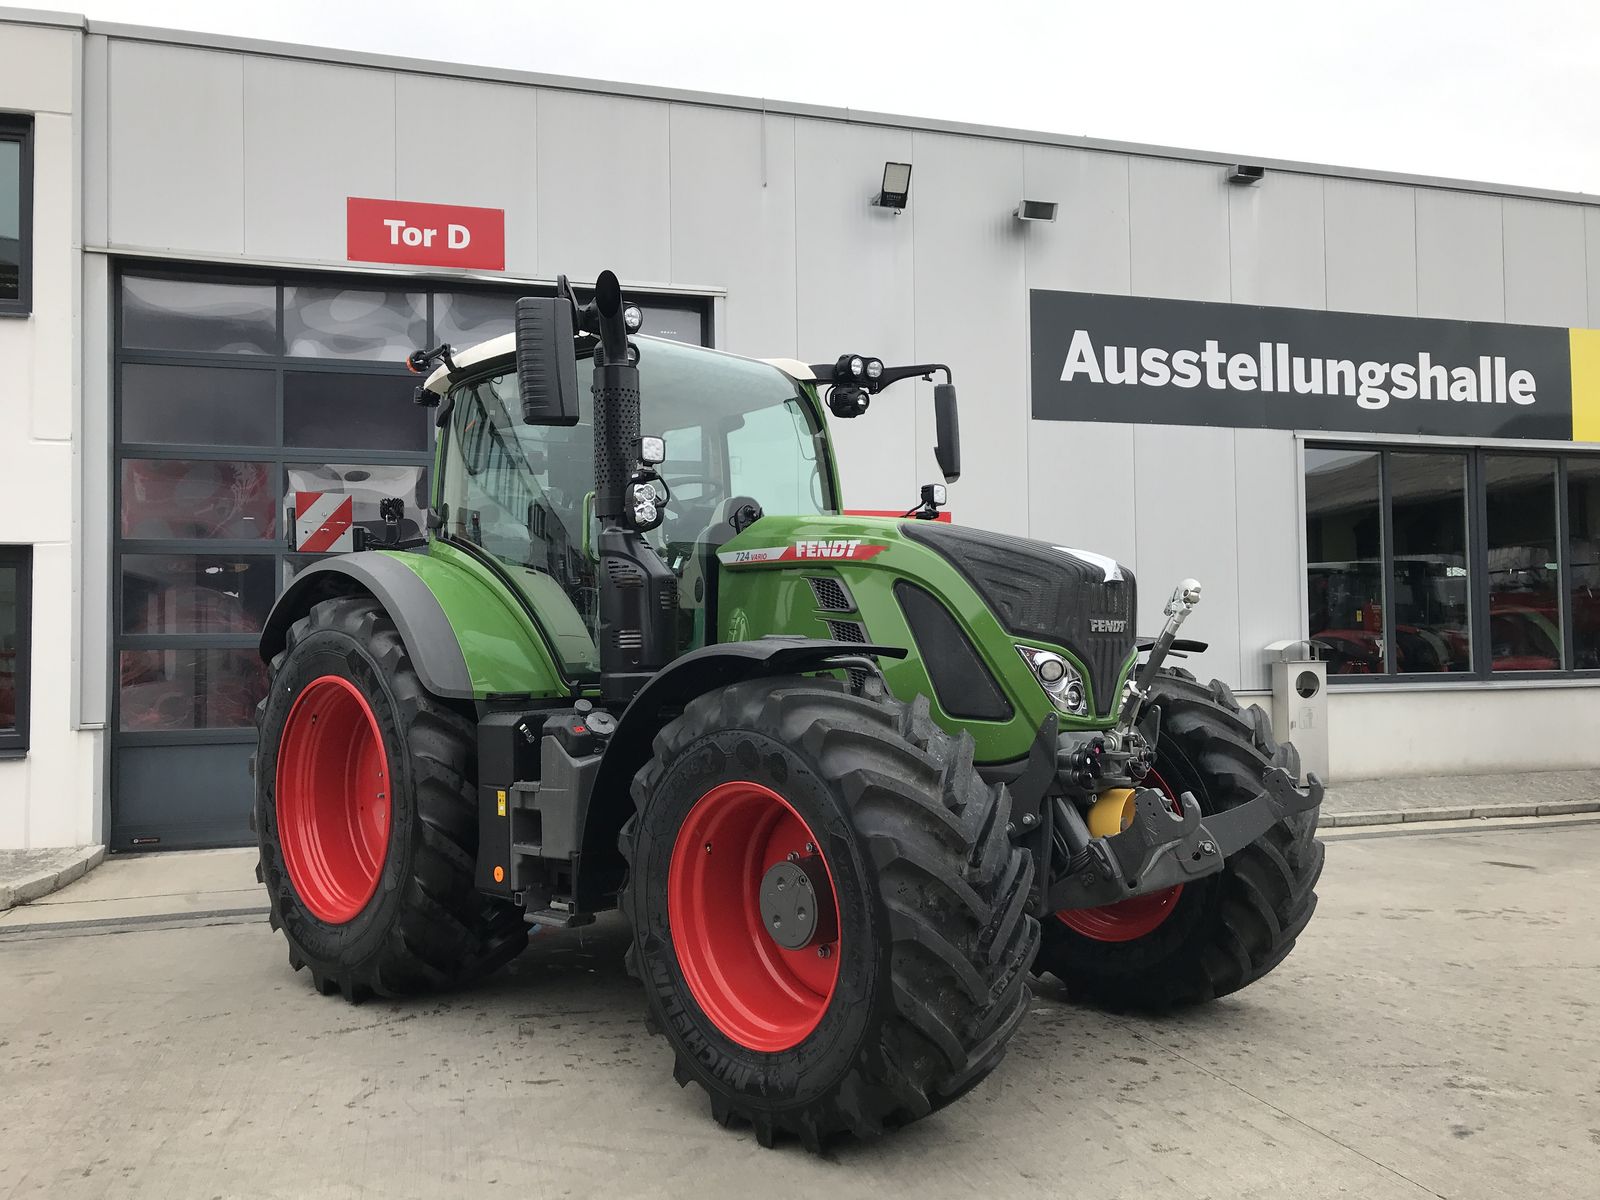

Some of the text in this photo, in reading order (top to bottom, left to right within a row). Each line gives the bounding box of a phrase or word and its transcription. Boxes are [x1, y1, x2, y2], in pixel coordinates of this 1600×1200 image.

[383, 218, 471, 249] Tor D
[1059, 329, 1537, 410] Ausstellungshalle
[735, 552, 768, 562] 724 VARIO
[795, 539, 861, 558] FENDT
[1089, 619, 1127, 633] FENDT
